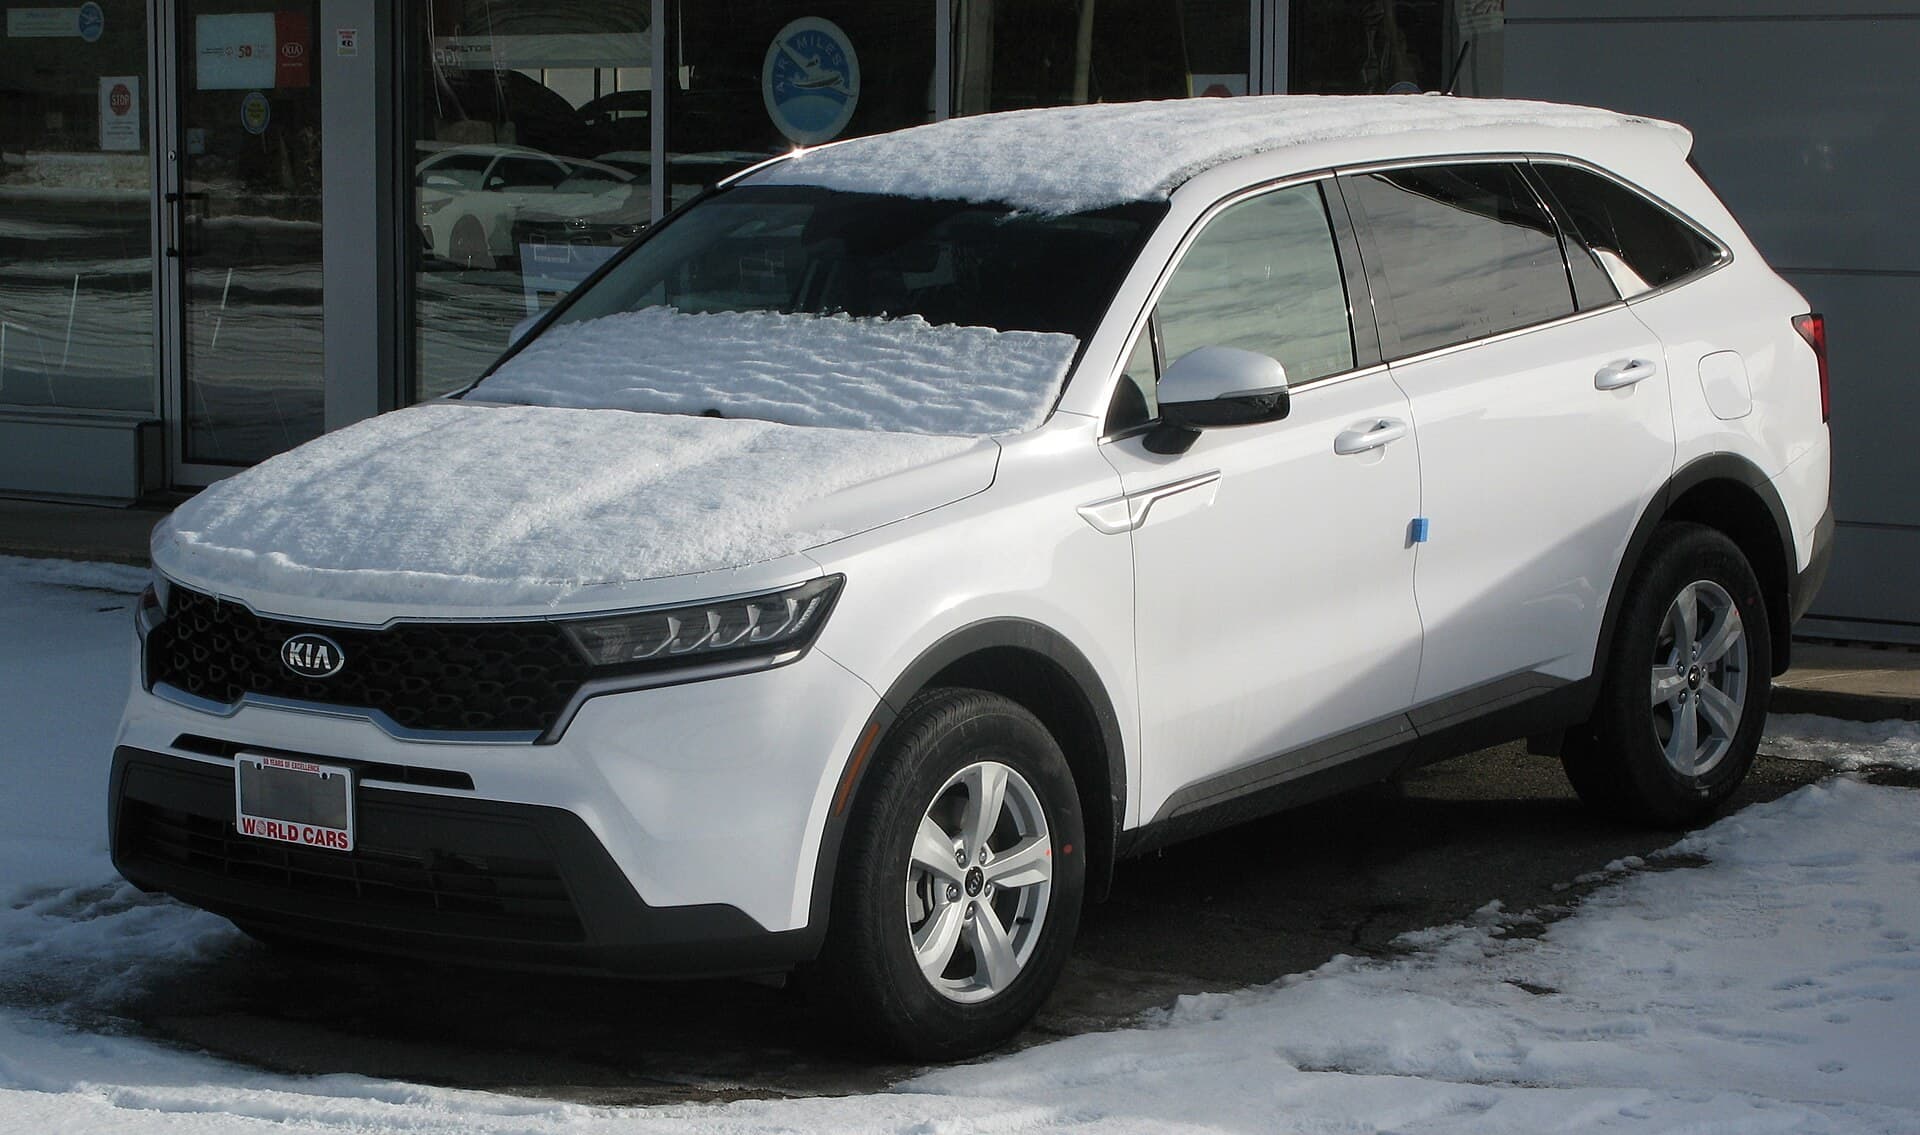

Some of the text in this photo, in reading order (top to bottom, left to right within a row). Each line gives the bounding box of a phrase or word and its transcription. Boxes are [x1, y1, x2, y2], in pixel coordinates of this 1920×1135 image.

[284, 44, 301, 56] KIA
[775, 35, 842, 96] AIR MILES
[111, 94, 130, 106] STOP
[289, 641, 331, 670] KIA
[242, 817, 348, 849] WORLD CARS
